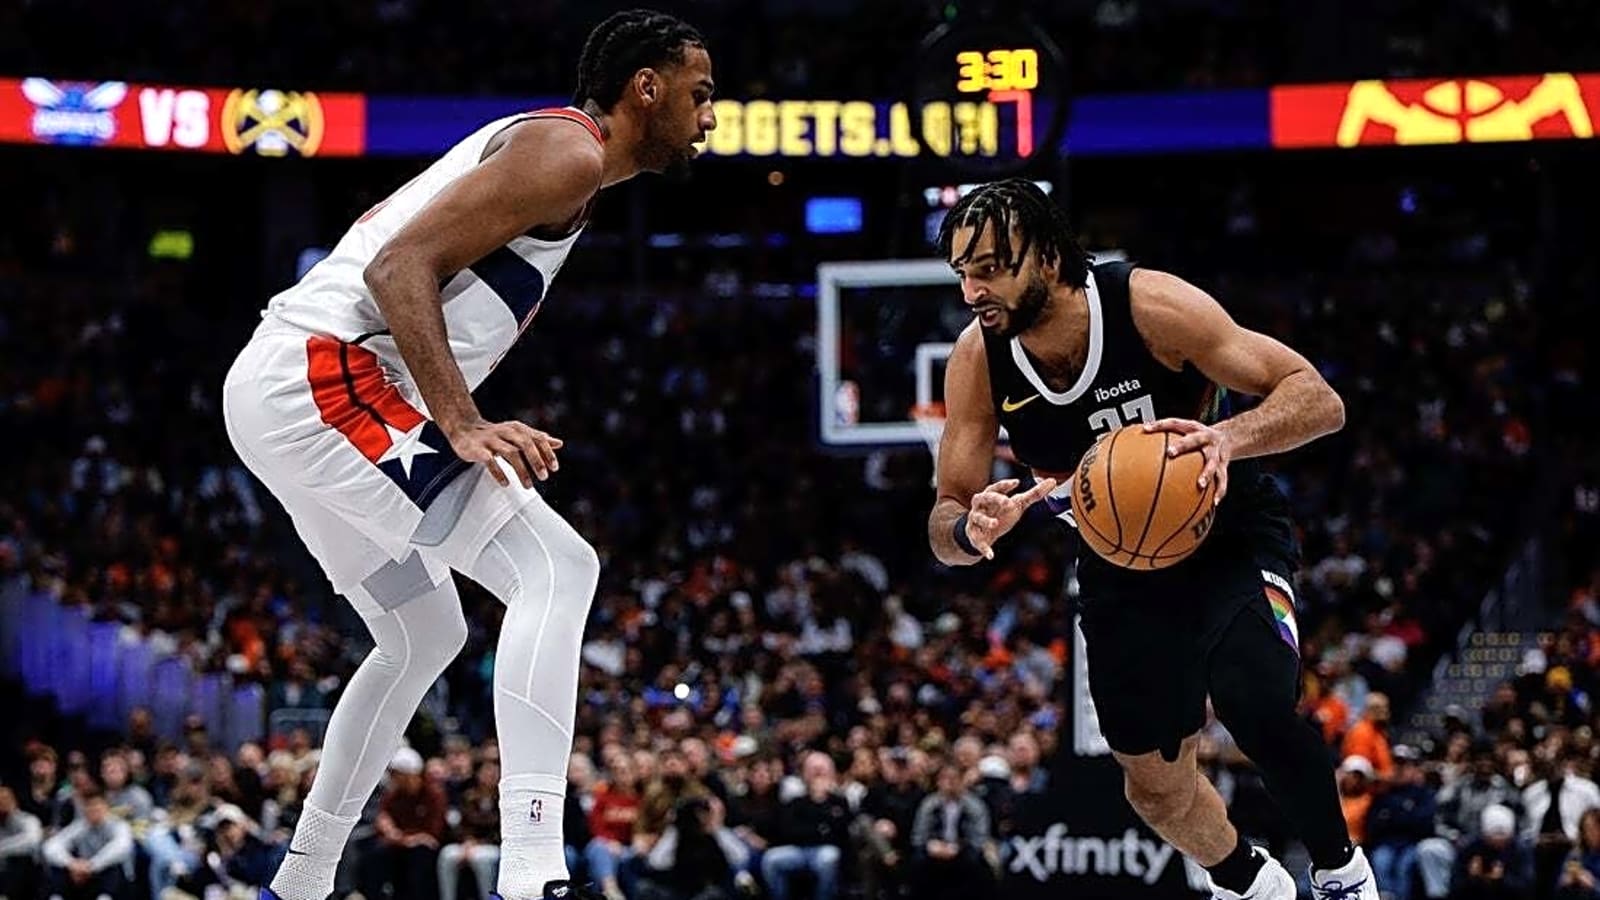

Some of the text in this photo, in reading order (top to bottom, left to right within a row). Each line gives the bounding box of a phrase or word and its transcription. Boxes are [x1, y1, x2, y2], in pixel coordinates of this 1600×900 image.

[956, 49, 1038, 92] 3:30
[138, 87, 211, 148] VS
[1094, 379, 1141, 402] ibotta
[1009, 822, 1174, 885] xfinity
